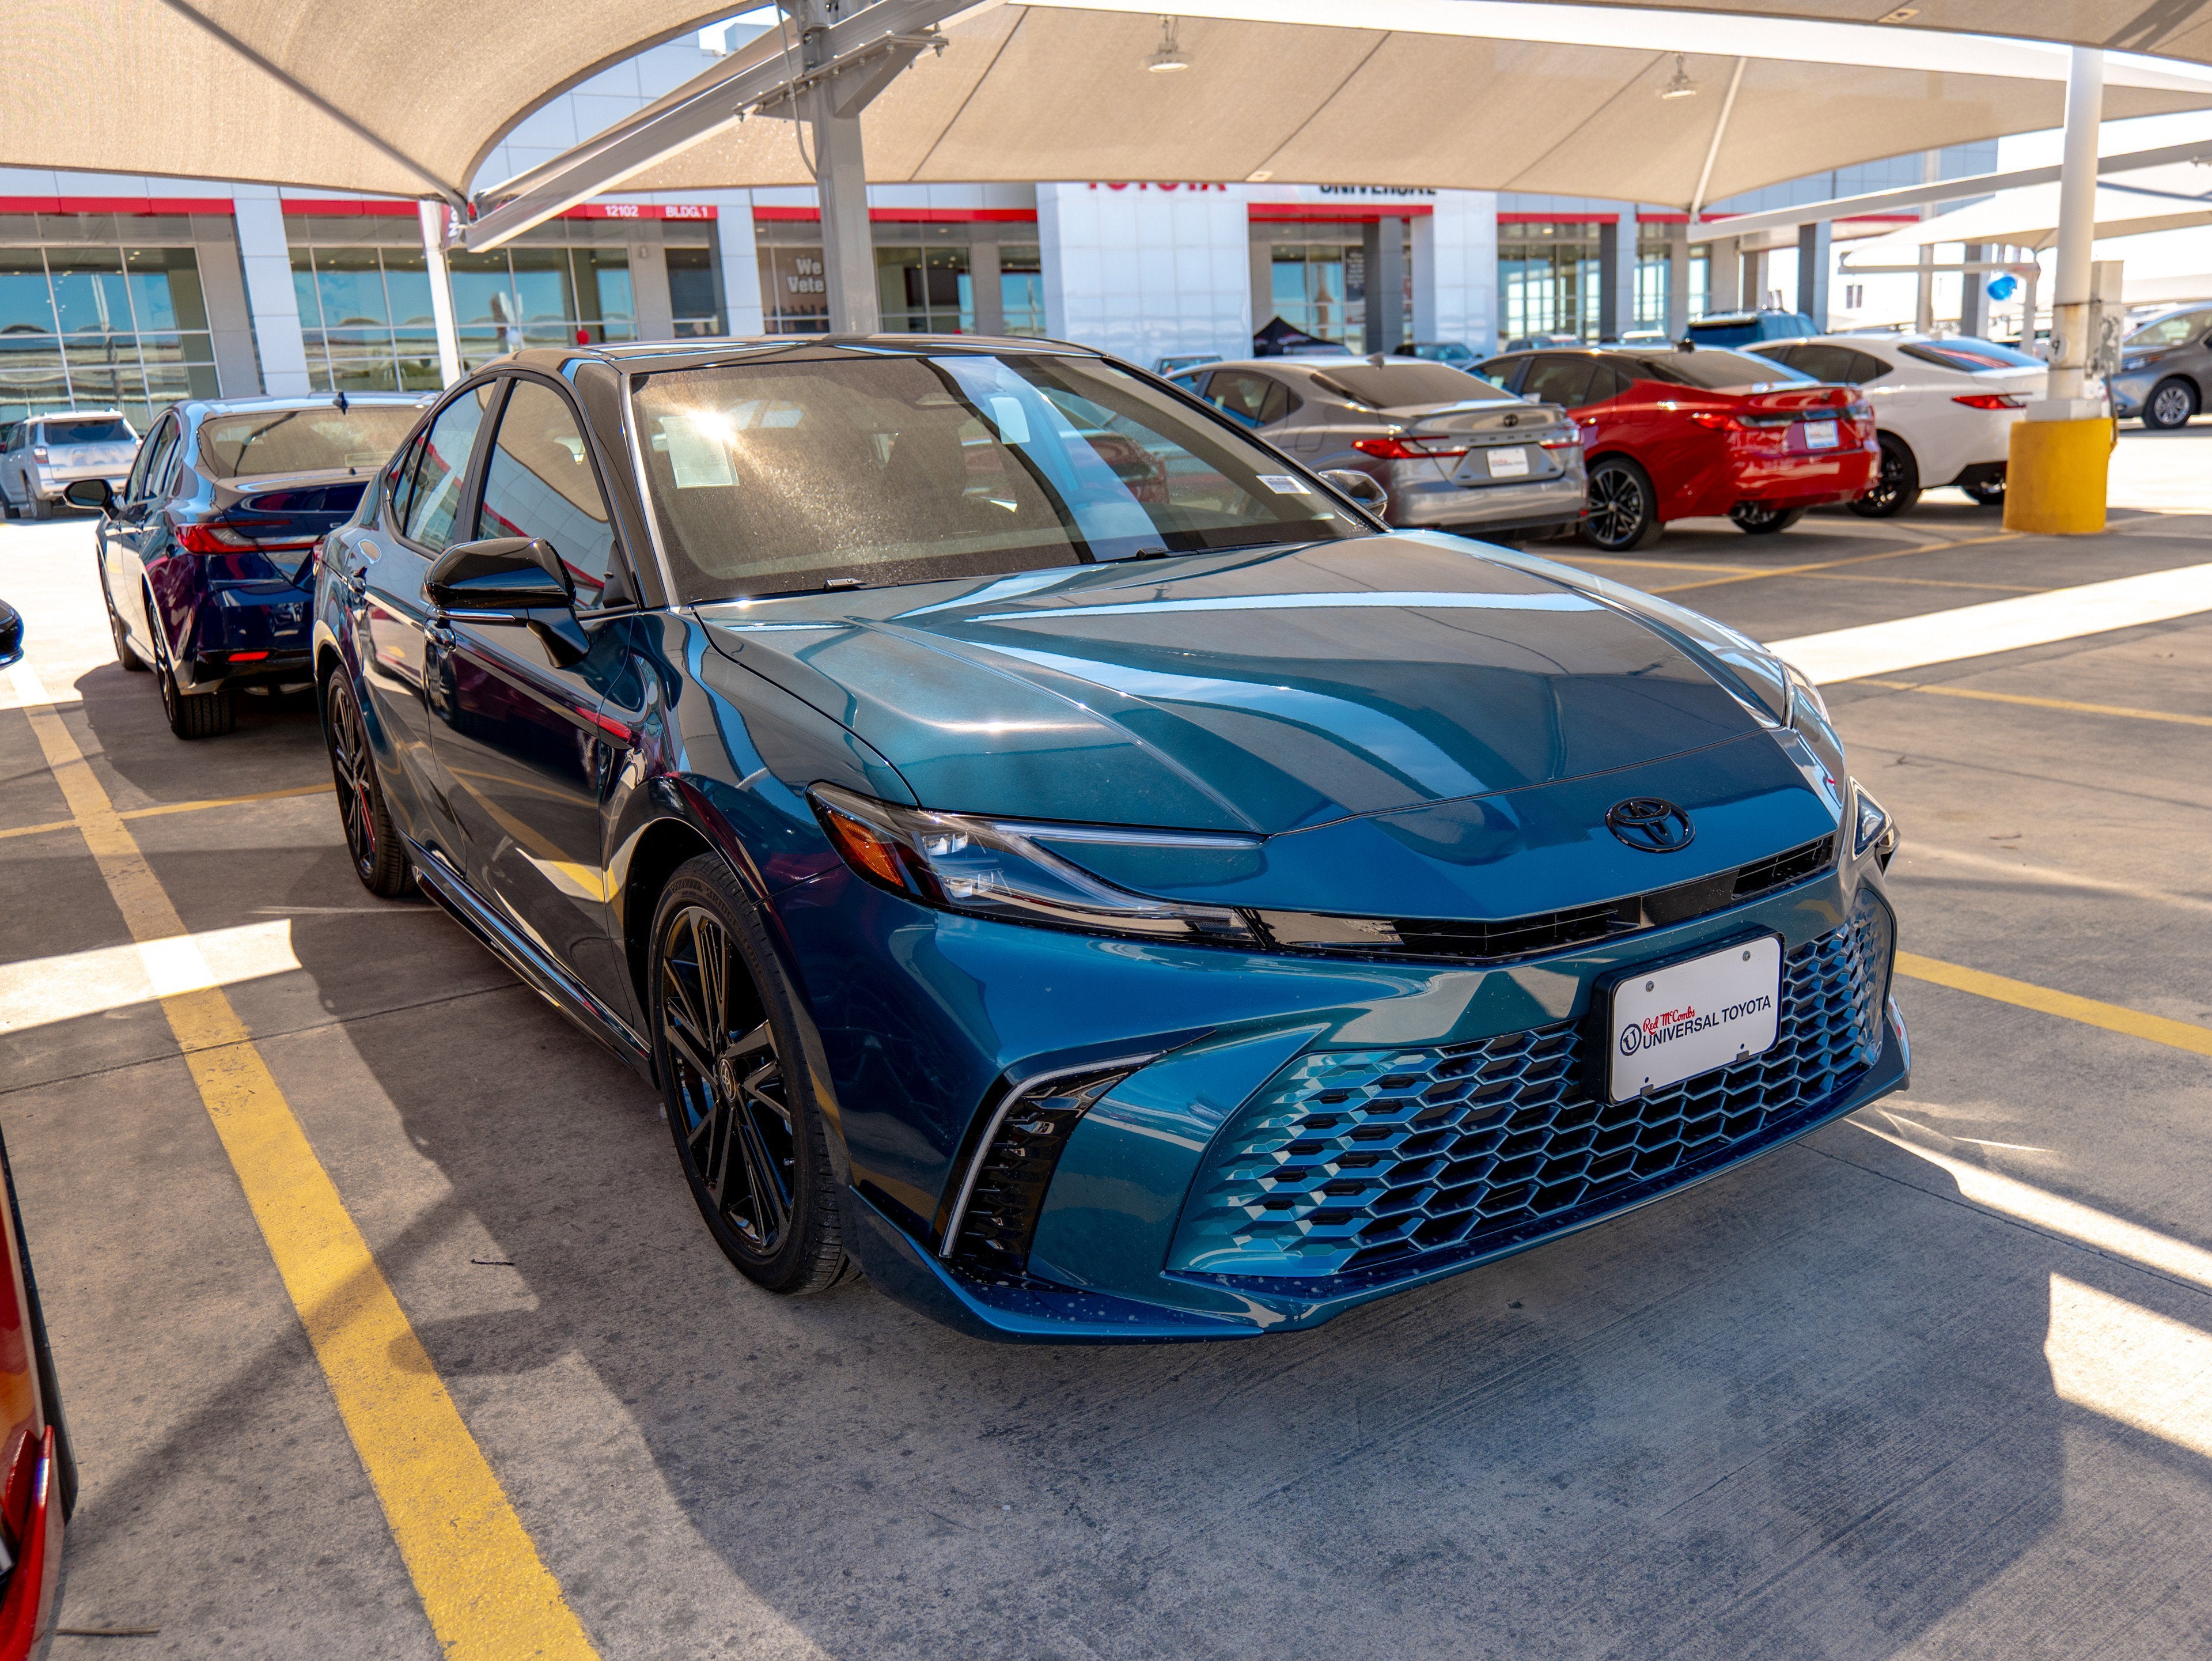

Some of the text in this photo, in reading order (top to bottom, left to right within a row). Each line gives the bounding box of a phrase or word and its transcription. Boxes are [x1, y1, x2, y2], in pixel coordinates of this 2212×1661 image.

[605, 205, 639, 217] 12102
[795, 258, 823, 275] We
[1643, 1005, 1695, 1035] Red McCombs
[1643, 995, 1771, 1049] UNIVERSAL TOYOTA
